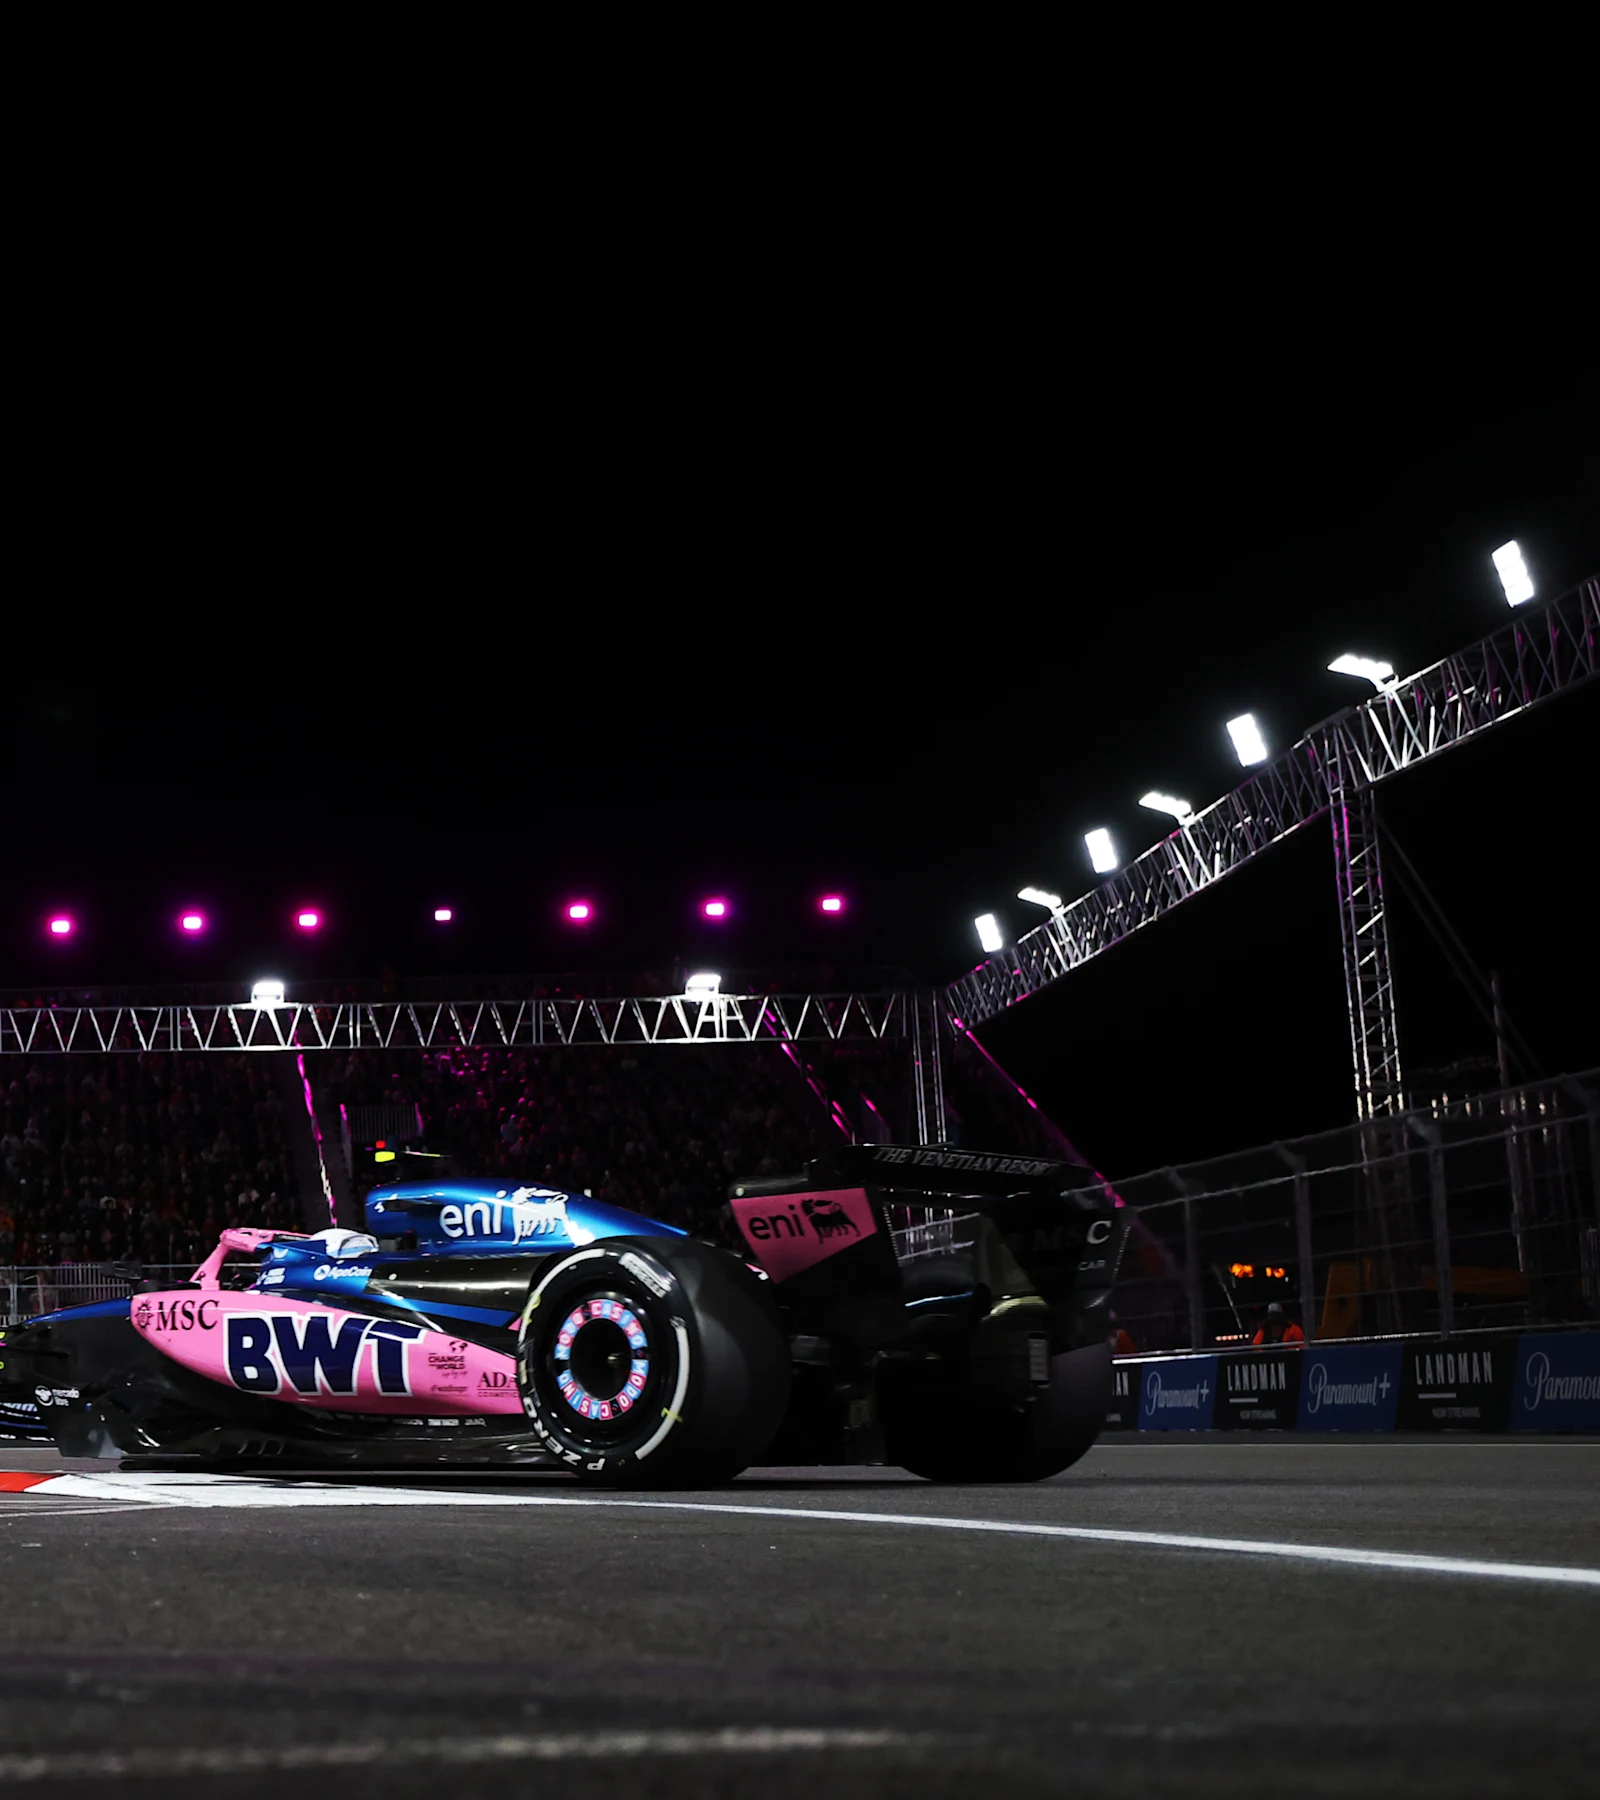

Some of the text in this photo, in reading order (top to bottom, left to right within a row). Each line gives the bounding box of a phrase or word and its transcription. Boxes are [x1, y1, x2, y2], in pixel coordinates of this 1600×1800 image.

[873, 1147, 1060, 1176] THE VENETIAN RESORT
[439, 1198, 502, 1238] eni
[749, 1205, 804, 1239] eni
[328, 1265, 373, 1279] ApeCoin
[156, 1300, 219, 1331] MSC
[223, 1312, 428, 1396] BWT
[1415, 1351, 1492, 1385] LANDMAN
[1145, 1371, 1209, 1416] Paramount+
[1227, 1362, 1286, 1391] LANDMAN
[1306, 1363, 1391, 1414] Paramount+
